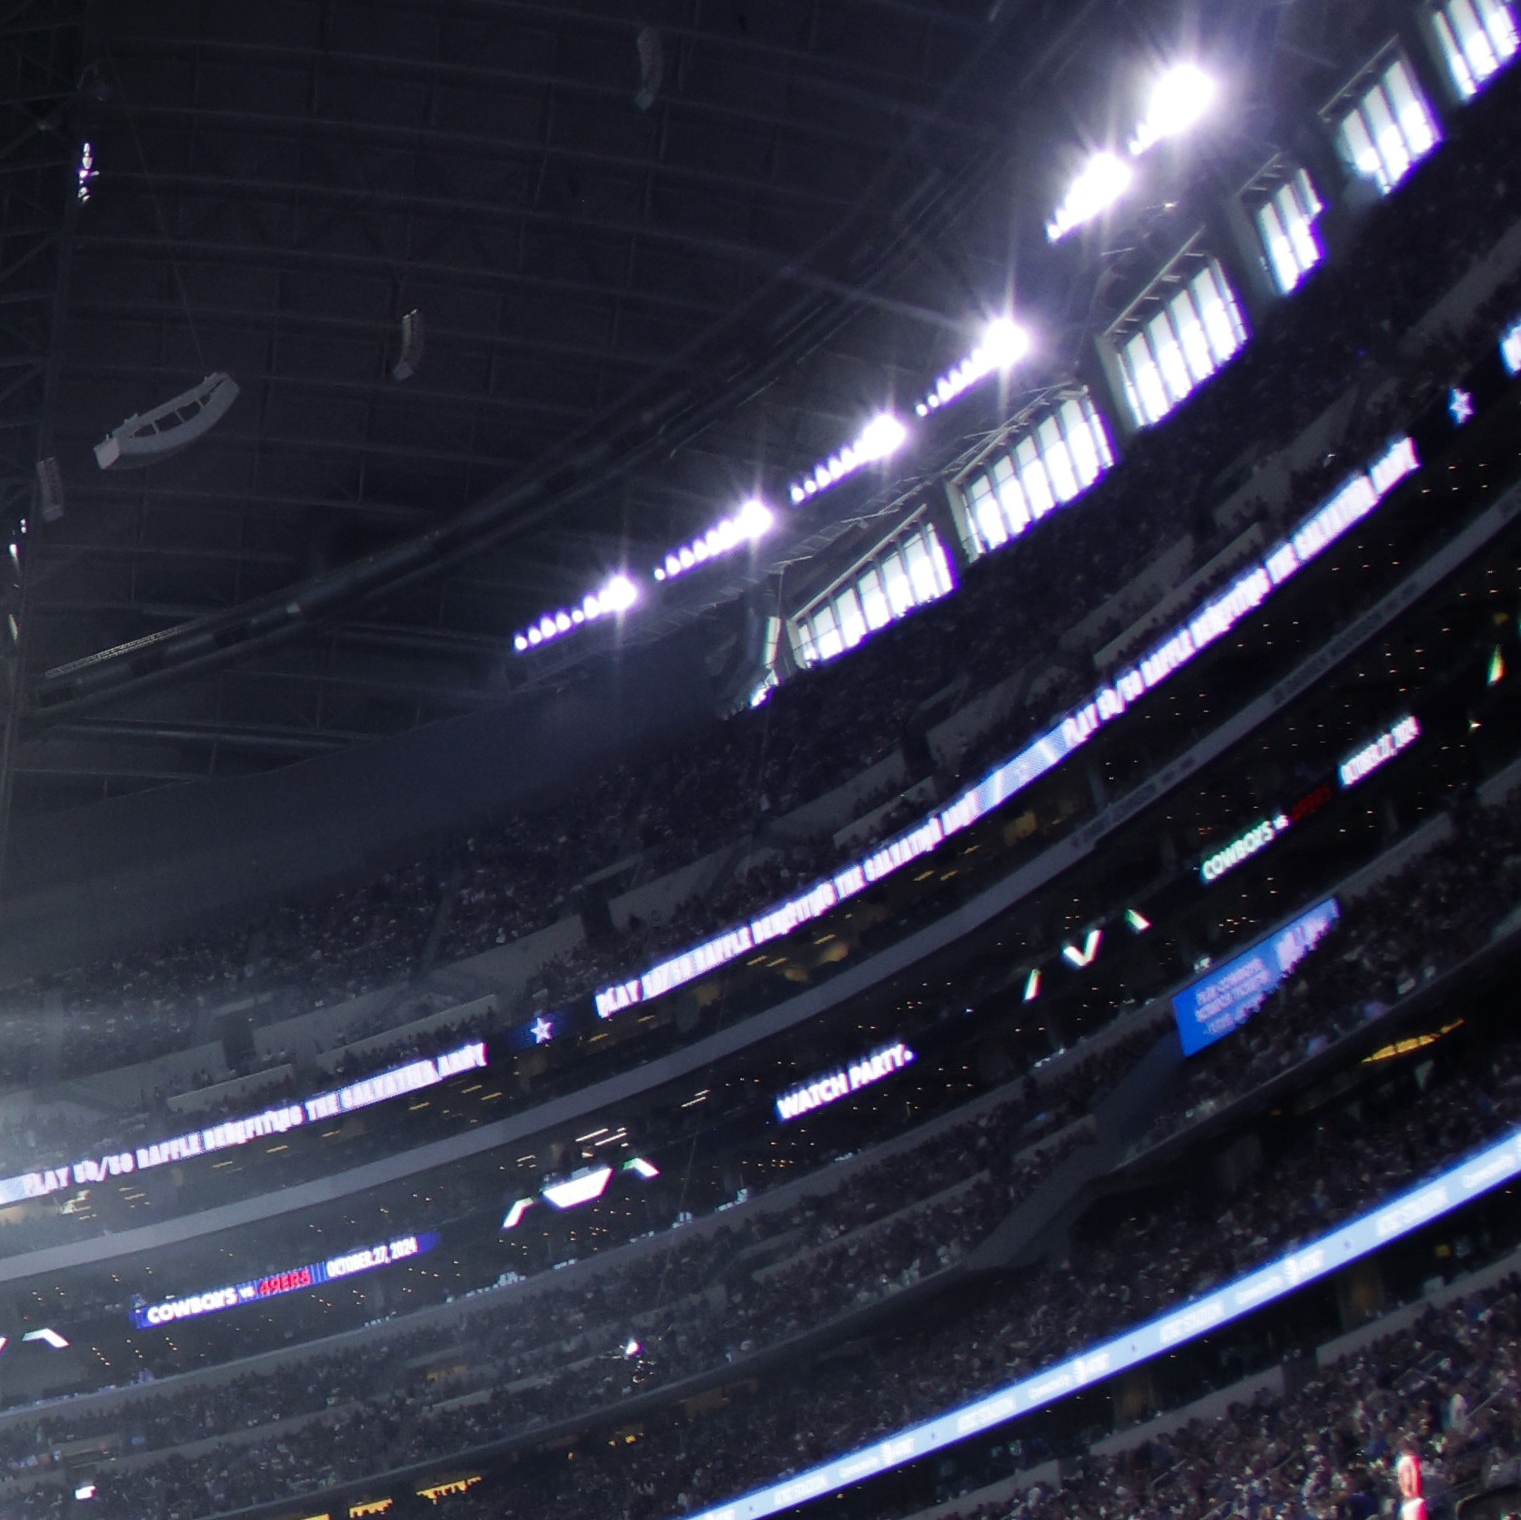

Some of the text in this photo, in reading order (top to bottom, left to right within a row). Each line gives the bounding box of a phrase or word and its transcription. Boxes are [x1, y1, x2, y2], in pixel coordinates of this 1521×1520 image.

[1203, 819, 1275, 882] COWBOYS
[777, 1072, 850, 1120] WATCH
[136, 1131, 202, 1169] RAFFLE
[147, 1286, 238, 1324] COWBOYS
[258, 1268, 312, 1295] 49ERS
[391, 1239, 419, 1261] 2024
